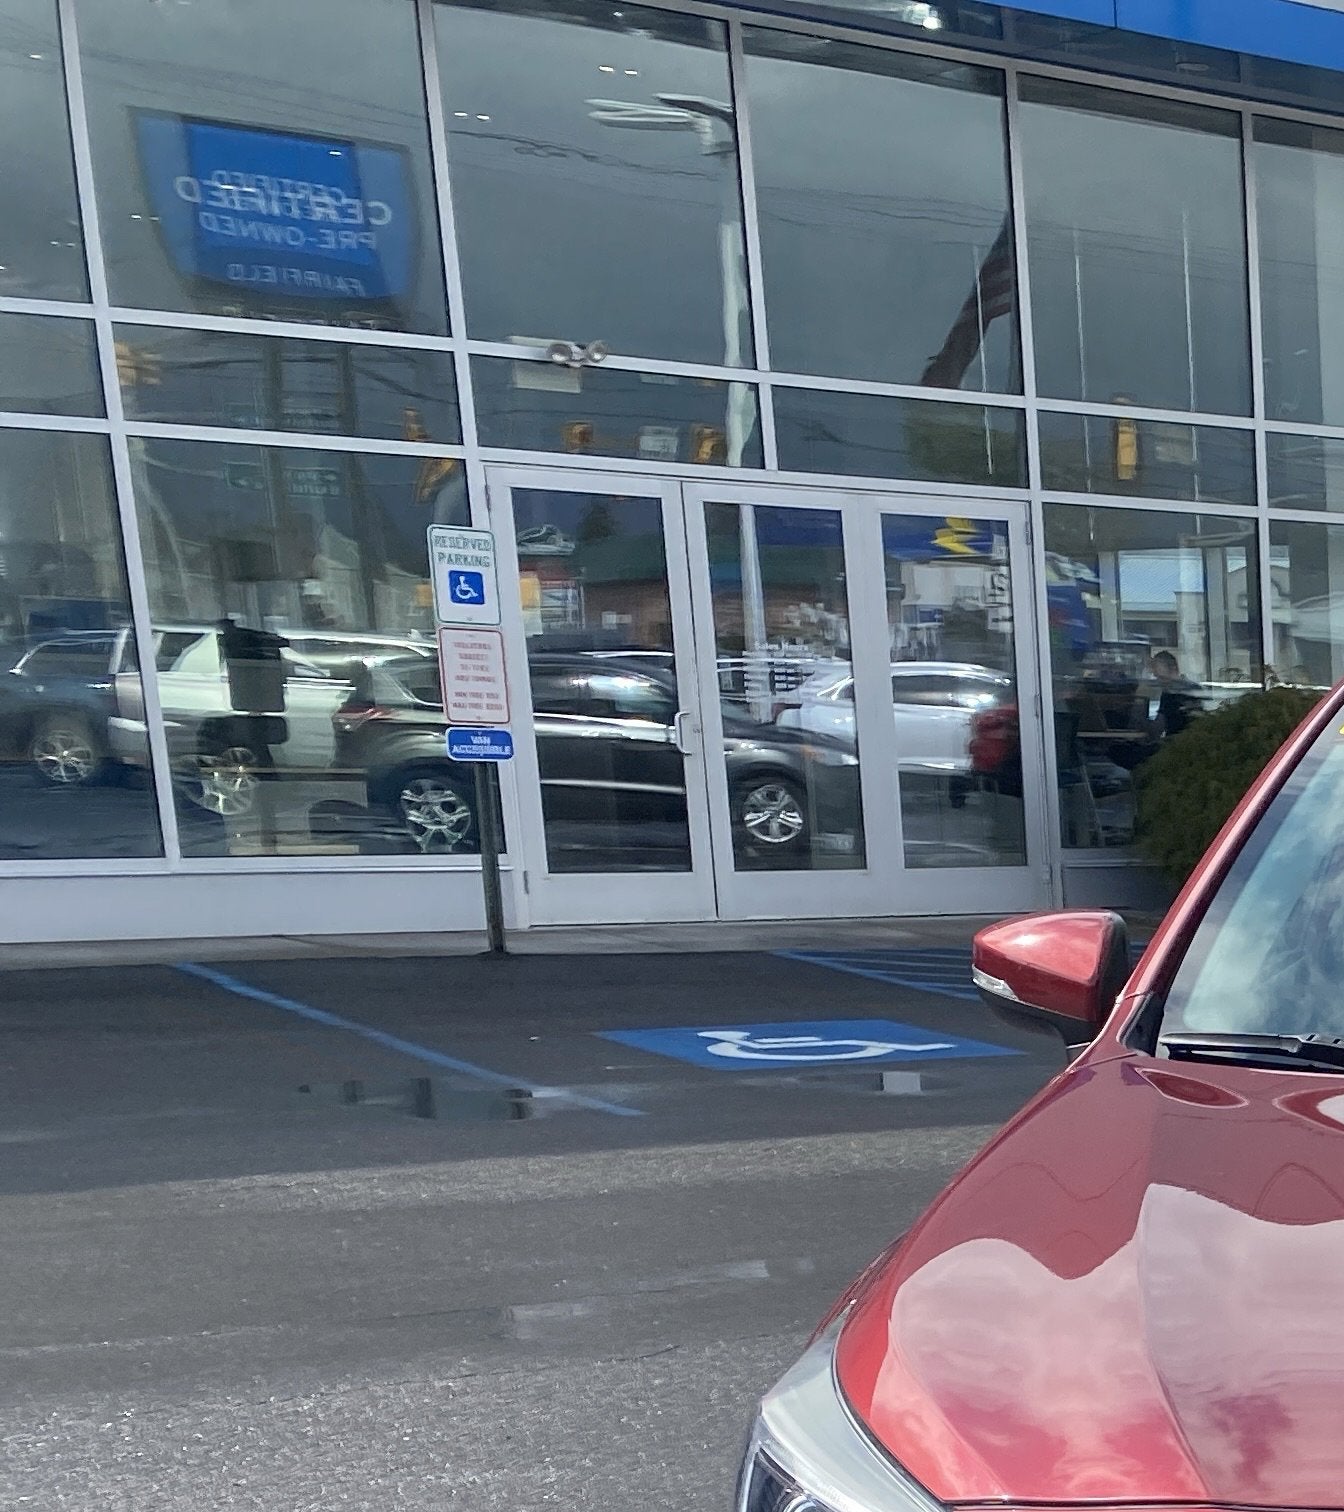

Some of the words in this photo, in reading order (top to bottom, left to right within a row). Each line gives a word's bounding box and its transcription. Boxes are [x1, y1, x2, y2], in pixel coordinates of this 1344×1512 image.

[434, 534, 491, 551] RESERVED
[437, 552, 490, 567] PARKING
[452, 745, 511, 755] ACCBLE
